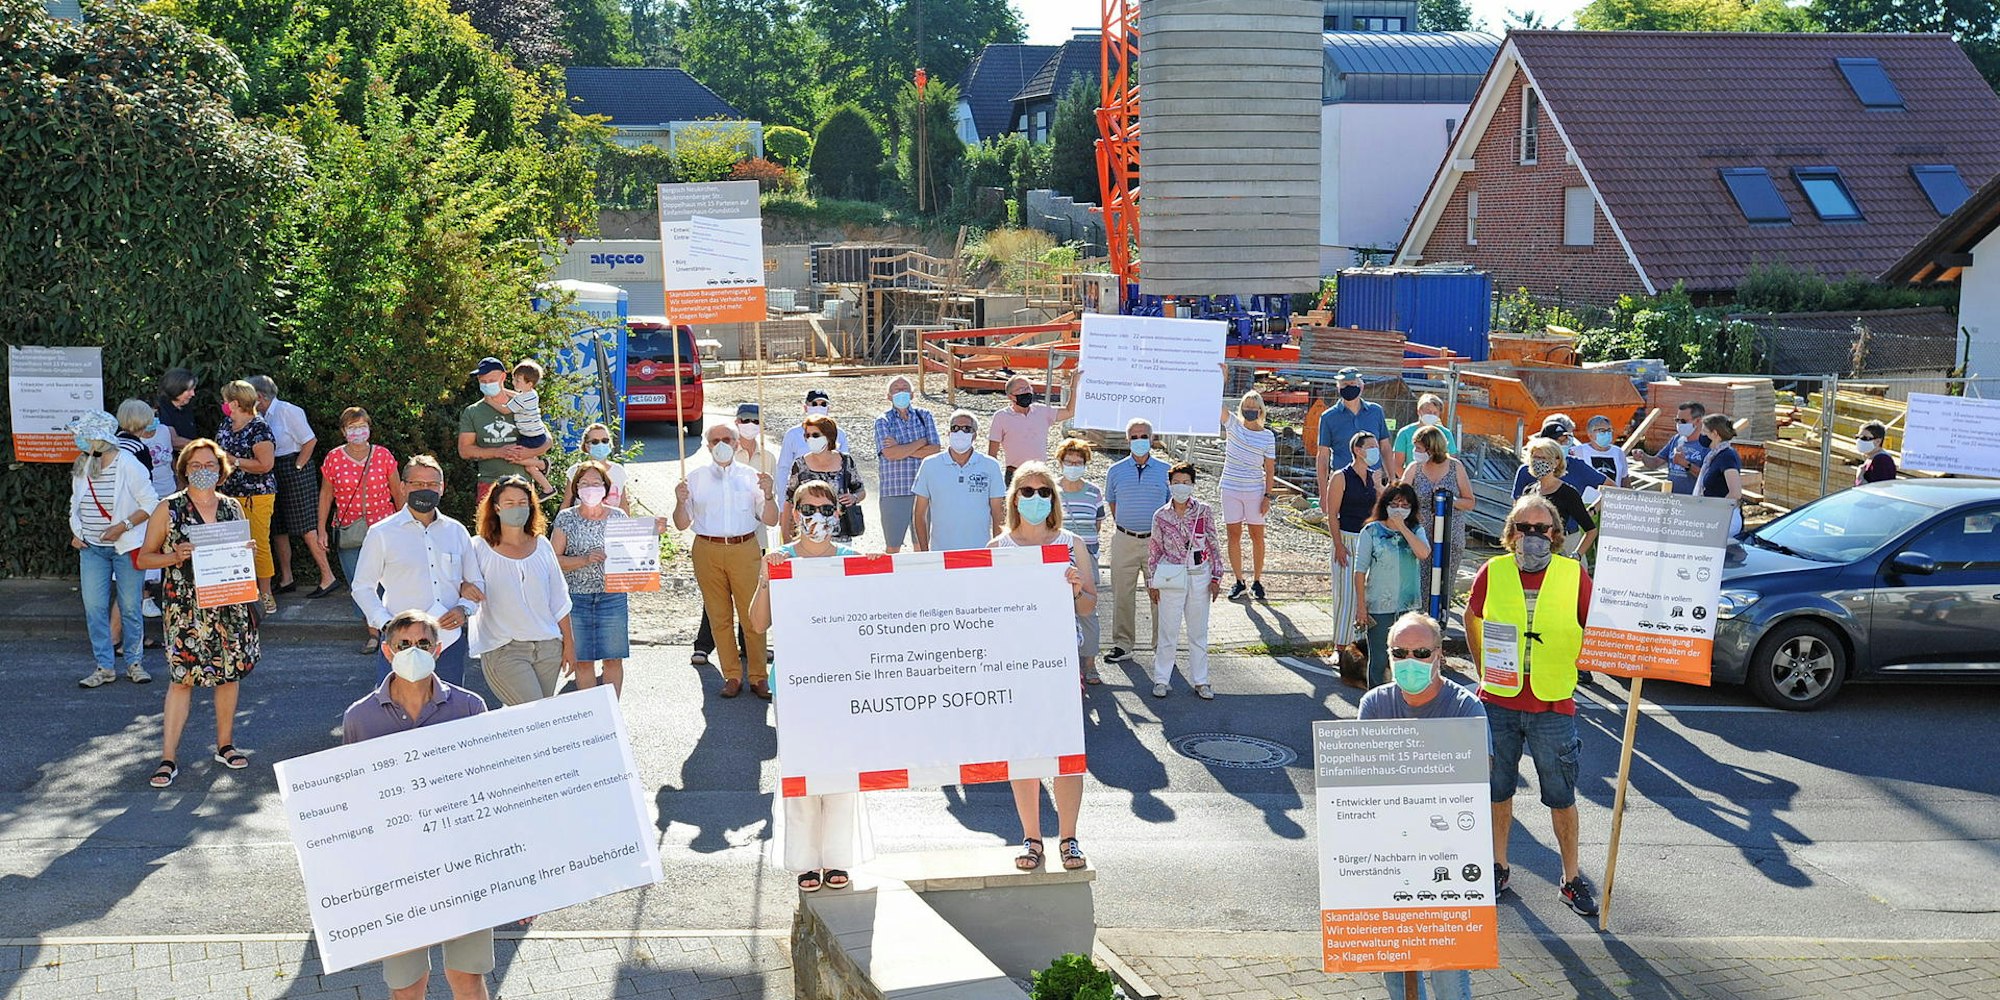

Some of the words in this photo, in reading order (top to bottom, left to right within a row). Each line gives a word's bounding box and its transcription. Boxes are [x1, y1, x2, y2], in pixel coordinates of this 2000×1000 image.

[1085, 391, 1128, 402] BAUSTOPP
[1129, 394, 1165, 404] SOFORT!
[1603, 500, 1670, 516] Neukronenberger
[1601, 510, 1646, 522] Doppelhaus
[1647, 516, 1661, 524] mit
[1662, 516, 1673, 525] 15
[1673, 517, 1705, 528] Parteien
[1705, 521, 1719, 530] auf
[1606, 554, 1637, 565] Eintracht
[1607, 544, 1644, 555] Entwickler
[1659, 550, 1686, 560] Bauamt
[1694, 554, 1713, 562] voller
[1599, 587, 1629, 597] Bürger/
[1628, 590, 1662, 601] Nachbarn
[1663, 594, 1670, 602] in
[1671, 595, 1693, 603] vollem
[1599, 596, 1649, 609] Unverständnis
[810, 615, 827, 624] Seit
[829, 614, 845, 623] Juni
[846, 613, 868, 622] 2020
[869, 611, 904, 621] arbeiten
[904, 610, 918, 619] die
[919, 608, 954, 619] fleißigen
[955, 606, 1002, 616] Bauarbeiter
[1003, 604, 1025, 613] mehr
[1026, 603, 1038, 611] als
[858, 624, 874, 636] 60
[876, 621, 927, 635] Stunden
[930, 622, 950, 634] pro
[952, 617, 994, 630] Woche
[1583, 637, 1597, 646] Wir
[1597, 639, 1635, 651] tolerieren
[1635, 643, 1649, 652] das
[1650, 645, 1687, 656] Verhalten
[1687, 649, 1701, 657] der
[1626, 632, 1694, 648] Baugenehmigung!
[870, 652, 904, 664] Firma
[907, 647, 987, 663] Zwingenberg:
[1580, 647, 1637, 662] Bauverwaltung
[1637, 653, 1657, 664] nicht
[1657, 657, 1680, 665] mehr.
[788, 672, 852, 687] Spendieren
[854, 670, 871, 681] Sie
[874, 668, 903, 679] Ihren
[906, 664, 977, 678] Bauarbeitern
[1005, 660, 1029, 671] eine
[1032, 656, 1067, 669] Pause!
[1591, 658, 1617, 669] Klagen
[1617, 660, 1644, 671] folgen!
[850, 694, 937, 715] BAUSTOPP
[942, 689, 1012, 708] SOFORT!
[1318, 726, 1359, 739] Bergisch
[1361, 725, 1419, 736] Neukirchen,
[291, 767, 366, 793] Bebauungsplan
[371, 758, 399, 772] 1989:
[403, 749, 420, 763] 22
[421, 744, 457, 758] weitere
[456, 727, 525, 749] Wohneinheiten
[525, 720, 551, 733] sollen
[552, 711, 594, 726] entstehen
[1319, 739, 1404, 751] Neukronenberger
[1406, 738, 1425, 748] Str.:
[1319, 751, 1377, 765] Doppelhaus
[1379, 752, 1397, 763] mit
[1398, 751, 1410, 762] 15
[1412, 750, 1455, 761] Parteien
[1455, 749, 1472, 760] auf
[299, 802, 349, 821] Bebauung
[378, 785, 406, 800] 2019:
[411, 777, 427, 791] 33
[428, 771, 464, 786] weitere
[464, 753, 532, 777] Wohneinheiten
[532, 747, 551, 760] sind
[551, 741, 581, 754] bereits
[582, 732, 618, 747] realisiert
[1320, 763, 1456, 777] Einfamilienhaus-Grundstück
[306, 825, 375, 849] Genehmigung
[385, 813, 413, 828] 2020:
[418, 808, 432, 818] für
[433, 799, 469, 814] weitere
[470, 791, 485, 805] 14
[486, 777, 554, 800] Wohneinheiten
[554, 768, 580, 782] erteilt
[423, 820, 437, 833] 47
[454, 814, 475, 826] statt
[475, 806, 492, 820] 22
[492, 792, 559, 815] Wohneinheiten
[559, 783, 593, 797] würden
[593, 772, 634, 788] entstehen
[1336, 797, 1382, 807] Entwickler
[1383, 796, 1401, 806] und
[1402, 796, 1437, 805] Bauamt
[1438, 796, 1448, 804] in
[1448, 794, 1474, 804] voller
[1337, 810, 1376, 820] Eintracht
[1338, 853, 1372, 865] Bürger/
[1373, 853, 1417, 863] Nachbarn
[1418, 852, 1427, 861] in
[1428, 852, 1459, 861] vollem
[320, 867, 441, 909] Oberbürgermeister
[444, 859, 472, 873] Uwe
[474, 842, 527, 865] Richrath:
[1339, 866, 1402, 877] Unverständnis
[328, 919, 383, 942] Stoppen
[385, 912, 405, 926] Sie
[407, 905, 427, 919] die
[429, 888, 488, 913] unsinnige
[490, 874, 537, 895] Planung
[538, 865, 566, 880] Ihrer
[568, 841, 640, 872] Baubehörde!
[1324, 911, 1381, 922] Skandalöse
[1382, 908, 1471, 922] Baugenehmigung!
[1324, 923, 1345, 935] Wir
[1346, 924, 1394, 935] tolerieren
[1396, 923, 1414, 934] das
[1415, 922, 1464, 933] Verhalten
[1465, 922, 1483, 932] der
[1327, 937, 1400, 949] Bauverwaltung
[1402, 936, 1427, 947] nicht
[1429, 935, 1457, 946] mehr.
[1342, 951, 1375, 963] Klagen
[1376, 950, 1411, 962] folgen!
